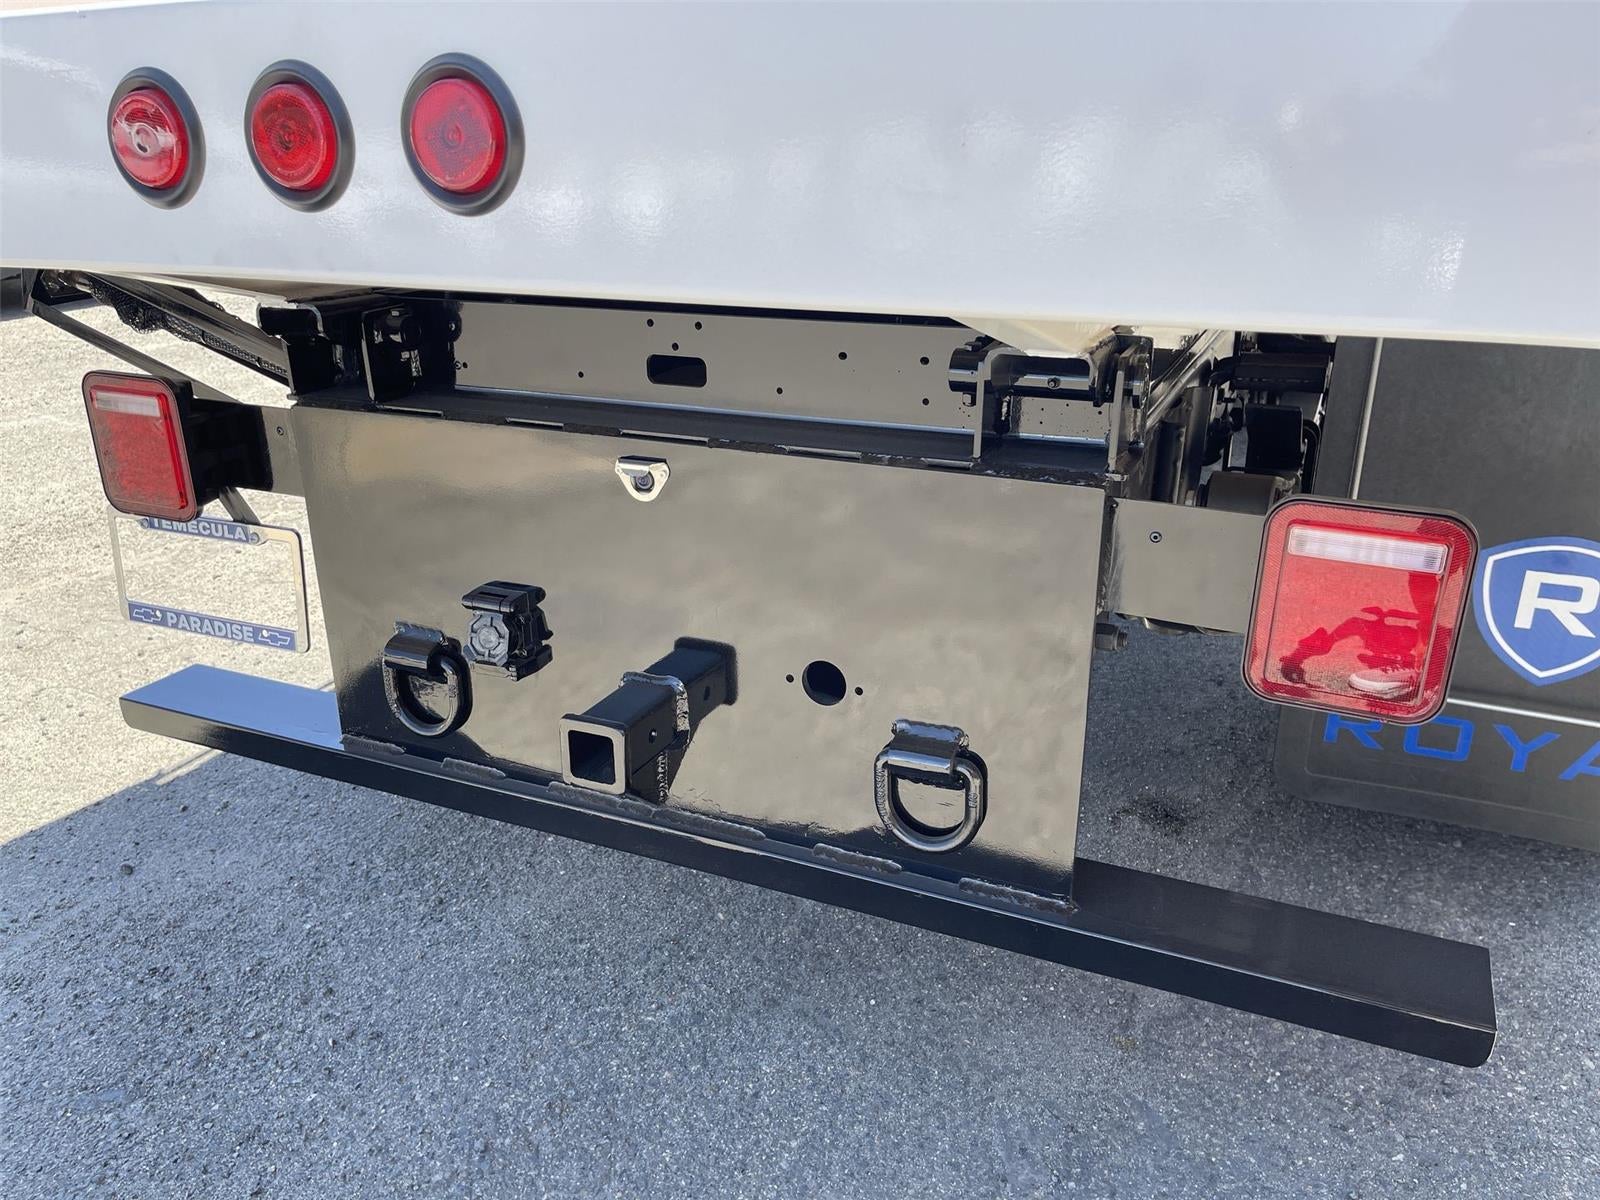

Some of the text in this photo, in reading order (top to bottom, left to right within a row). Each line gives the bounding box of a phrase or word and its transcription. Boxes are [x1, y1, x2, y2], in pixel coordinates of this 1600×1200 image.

[153, 518, 247, 541] TEMECULA
[1514, 570, 1600, 638] R
[166, 612, 255, 643] PARADISE
